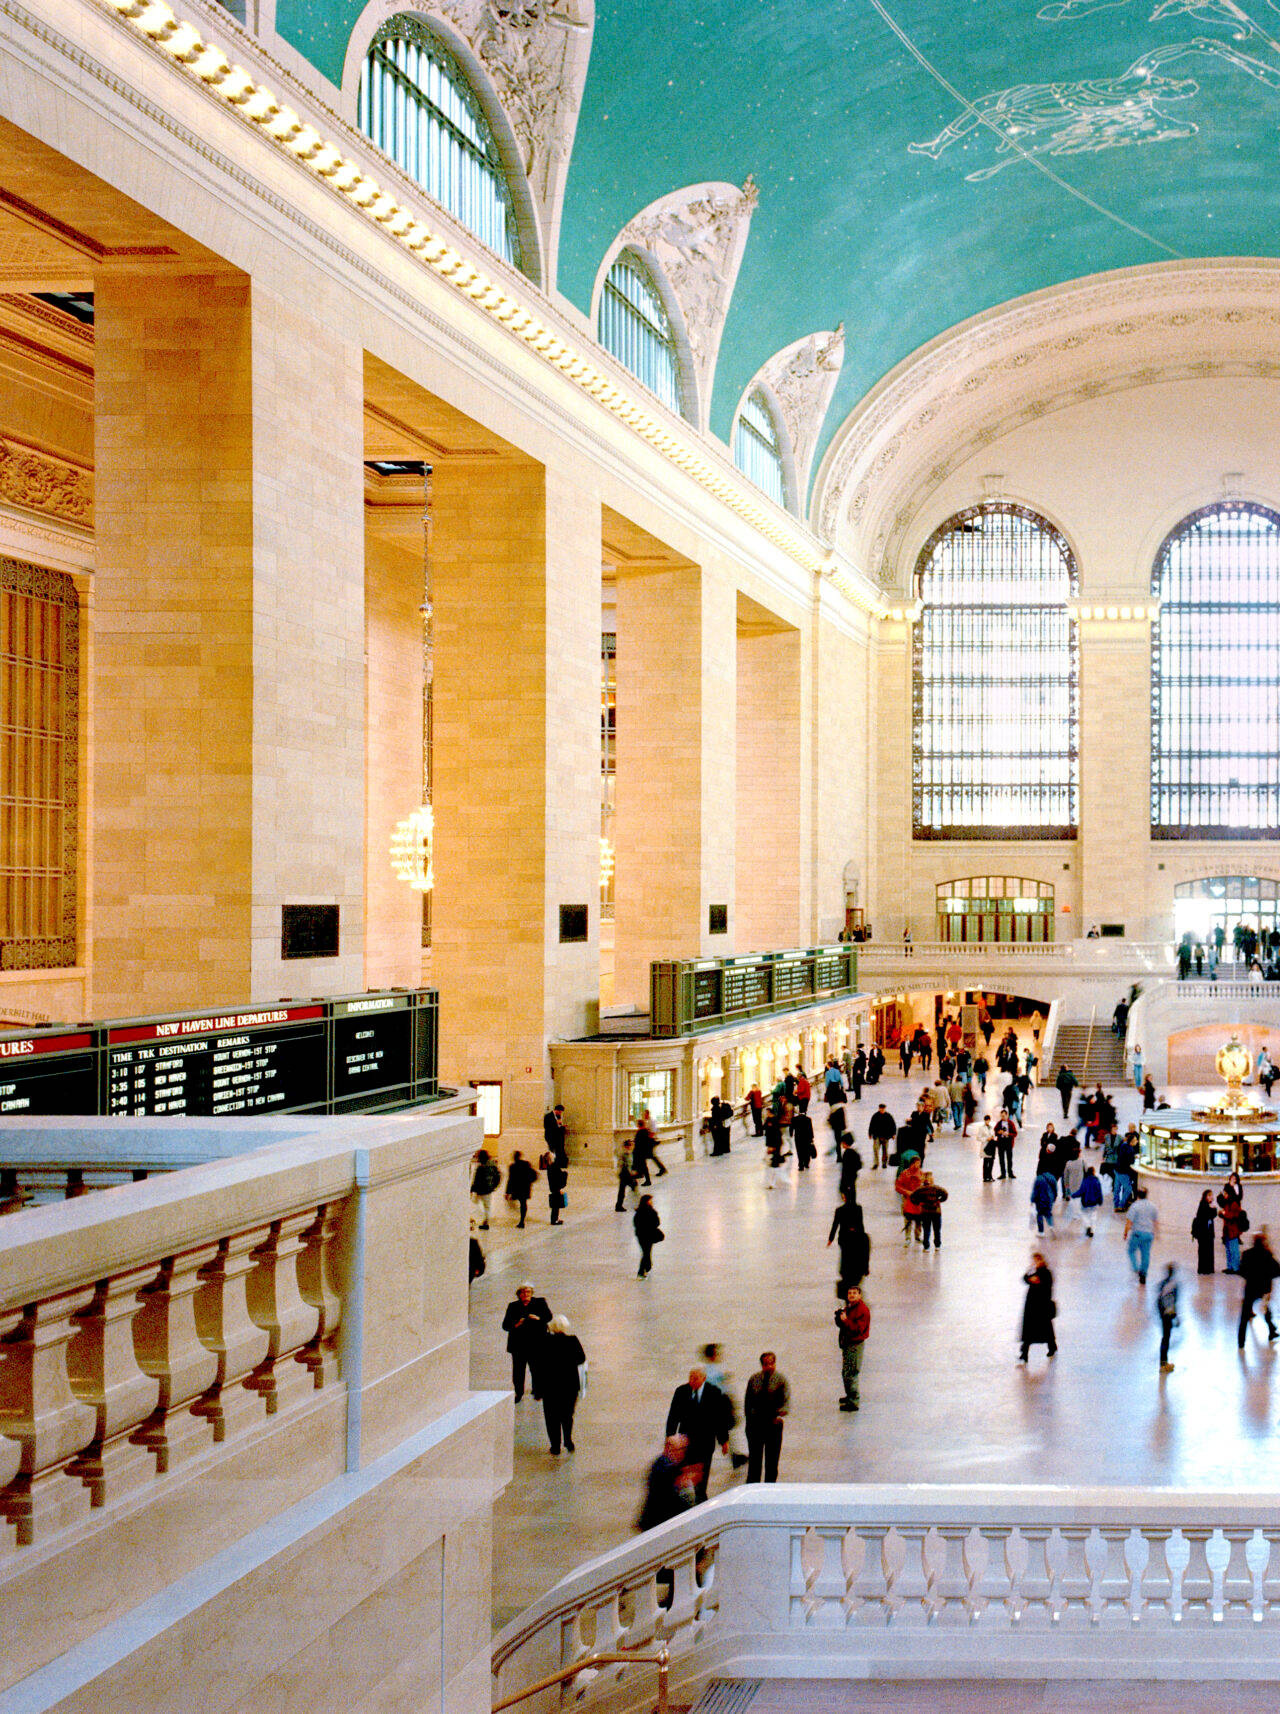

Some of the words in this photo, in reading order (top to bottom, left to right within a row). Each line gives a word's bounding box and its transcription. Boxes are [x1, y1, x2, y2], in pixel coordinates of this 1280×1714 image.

[347, 997, 394, 1013] INFORMATION
[156, 1022, 180, 1036] NEW
[181, 1017, 213, 1033] HAVEN
[215, 1015, 236, 1029] LINE
[237, 1009, 288, 1026] DEPARTURES
[0, 1040, 34, 1056] URES
[111, 1067, 128, 1079] 3:10
[134, 1064, 146, 1075] 107
[264, 1044, 278, 1055] STOP
[112, 1052, 133, 1063] TIME
[138, 1049, 155, 1060] TRK
[159, 1041, 208, 1057] DESTINATION
[217, 1035, 250, 1048] REMARKS
[111, 1081, 128, 1094] 3:35
[255, 1057, 269, 1068] STOP
[111, 1095, 128, 1108] 3:40
[134, 1092, 146, 1104] 114
[264, 1069, 278, 1080] STOP
[246, 1084, 260, 1095] STOP
